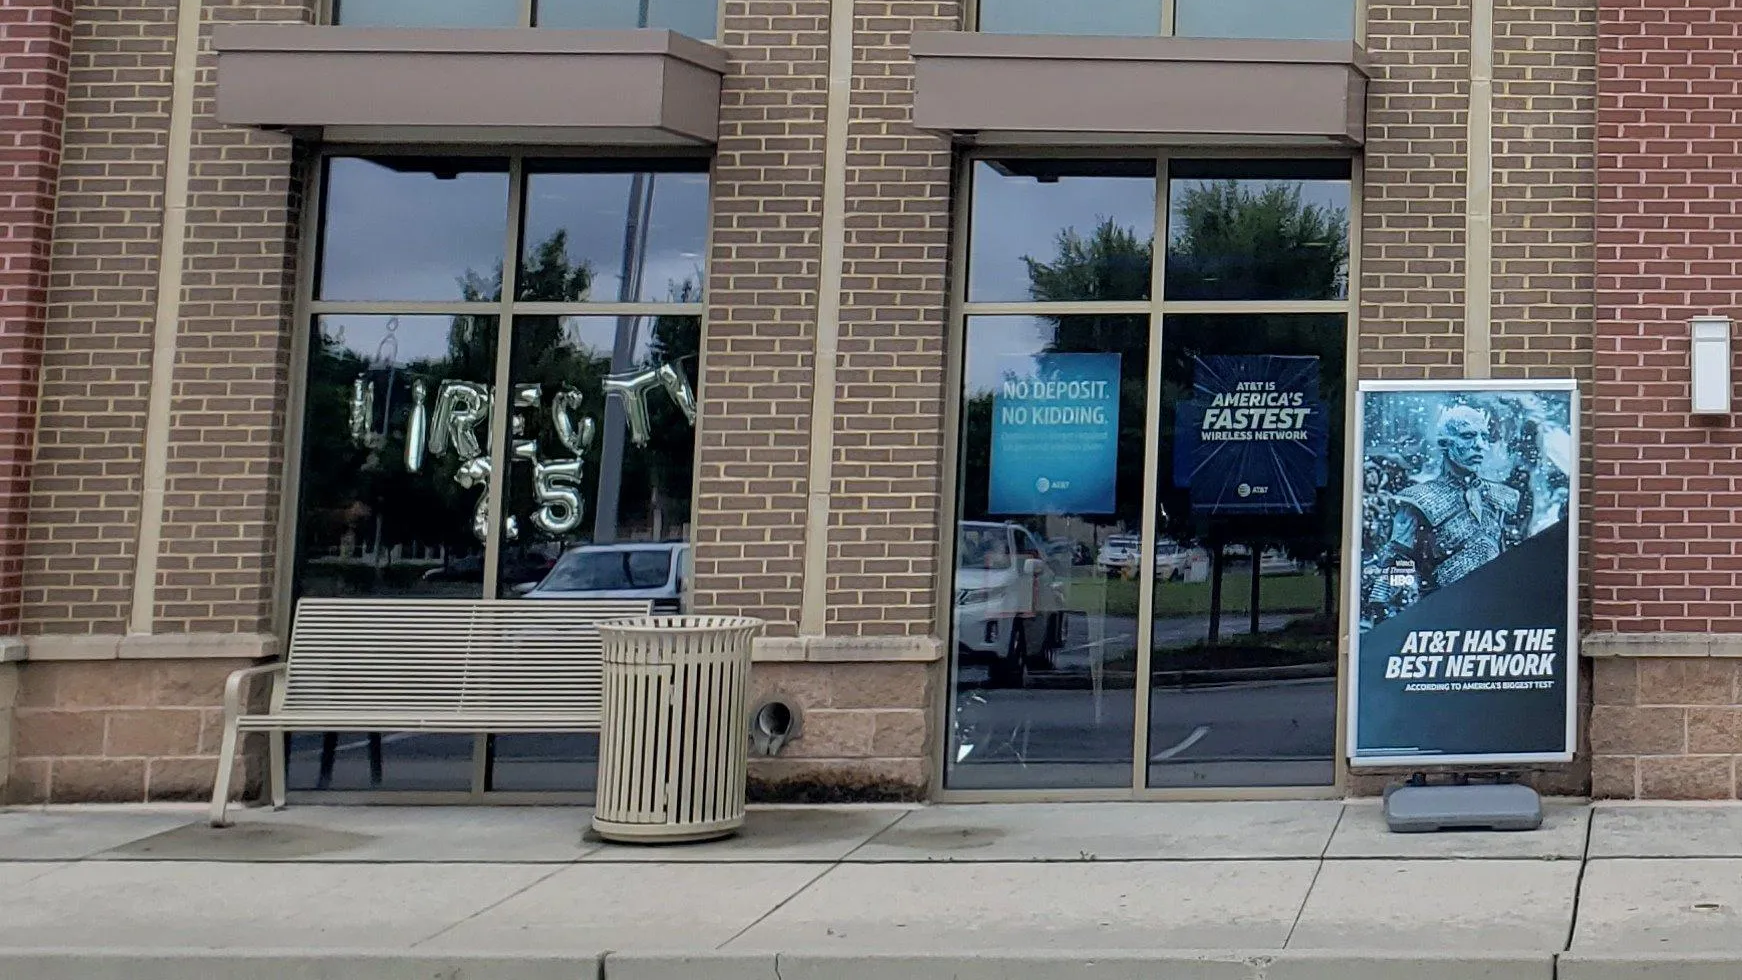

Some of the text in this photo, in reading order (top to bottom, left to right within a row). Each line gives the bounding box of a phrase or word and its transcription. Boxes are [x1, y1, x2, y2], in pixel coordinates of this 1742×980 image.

[1003, 380, 1110, 400] NO DEPOSIT.
[1236, 381, 1275, 391] AT&T IS
[1211, 392, 1303, 407] AMERICA'S
[1002, 406, 1109, 425] NO KIDDING.
[1202, 408, 1311, 430] FASTEST
[1201, 430, 1308, 441] WIRELESS NETWORK
[1390, 574, 1415, 587] HBO
[1401, 628, 1556, 654] AT&T HAS THE
[1384, 653, 1557, 680] BEST NETWORK
[1404, 682, 1450, 692] ACCORDING
[1451, 682, 1461, 691] TO
[1462, 681, 1502, 690] AMERICA'S
[1502, 681, 1533, 689] BIGGEST
